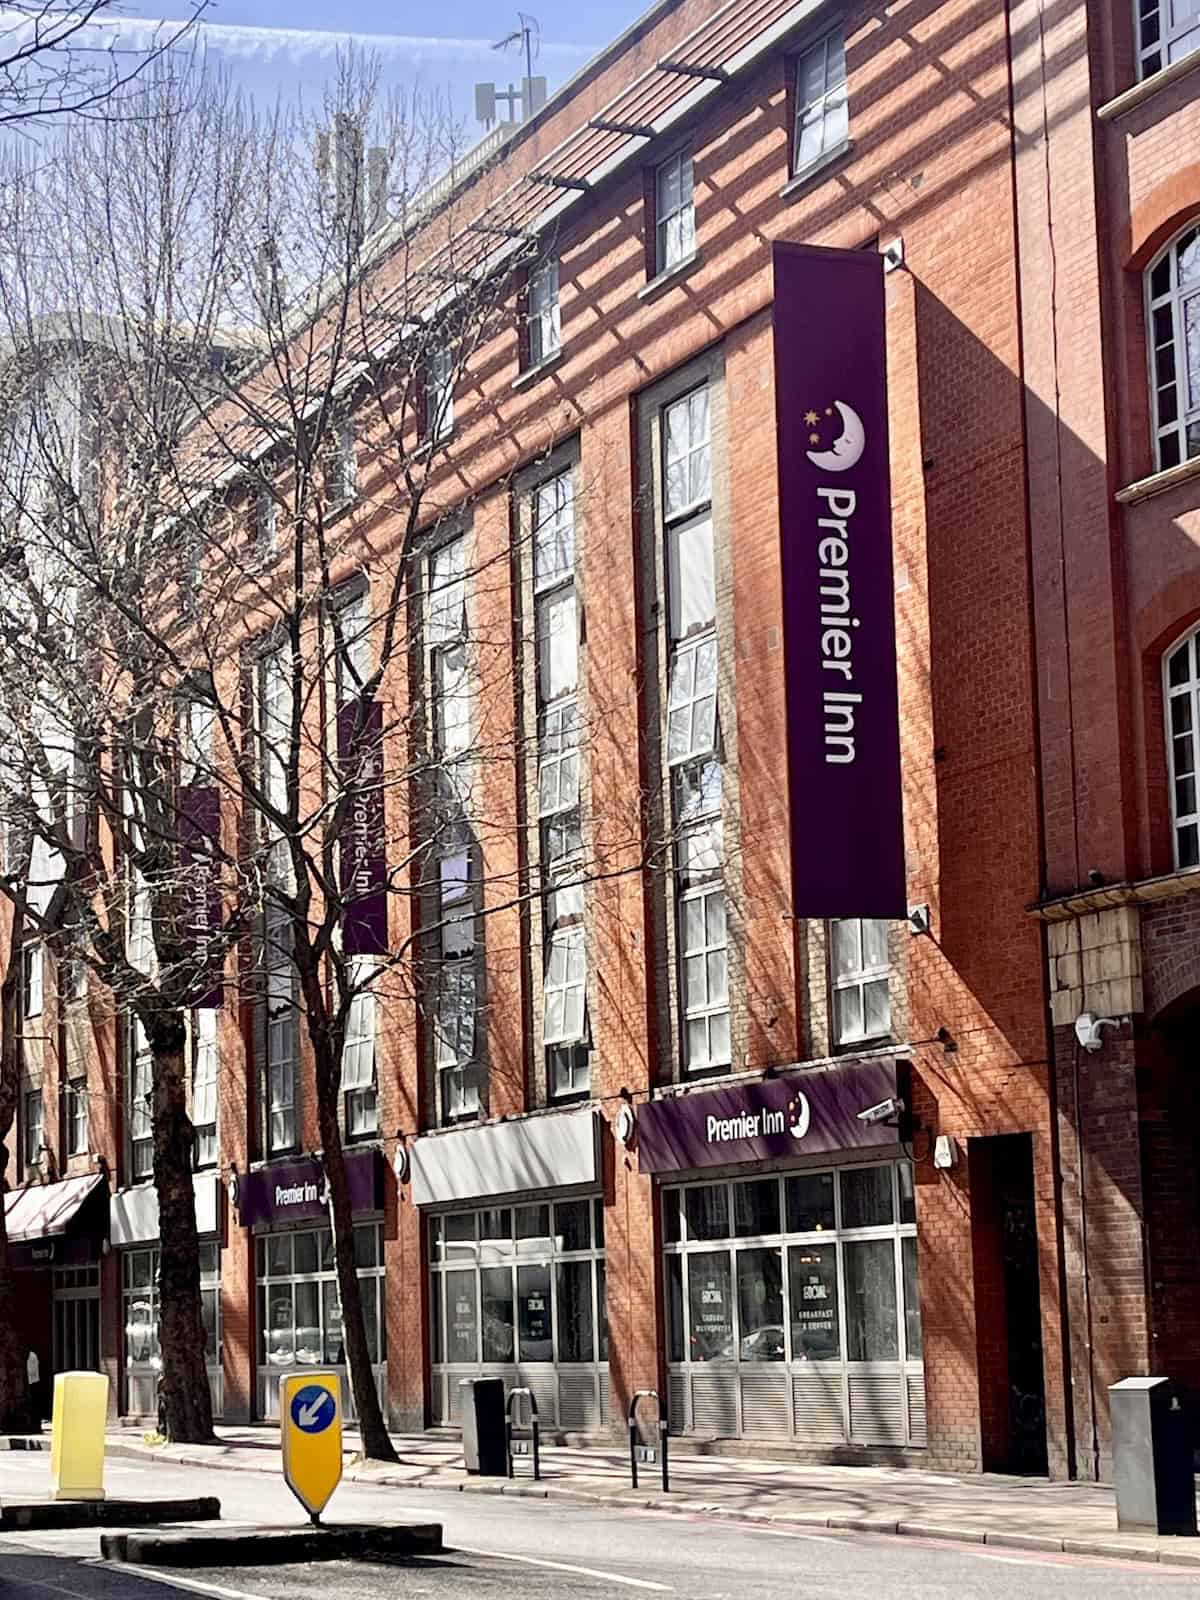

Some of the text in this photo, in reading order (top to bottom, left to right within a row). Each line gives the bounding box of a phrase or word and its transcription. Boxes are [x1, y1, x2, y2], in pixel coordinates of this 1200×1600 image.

[816, 487, 863, 763] Premier Inn
[707, 1107, 785, 1143] Premier Inn
[275, 1181, 318, 1207] Premier Inn
